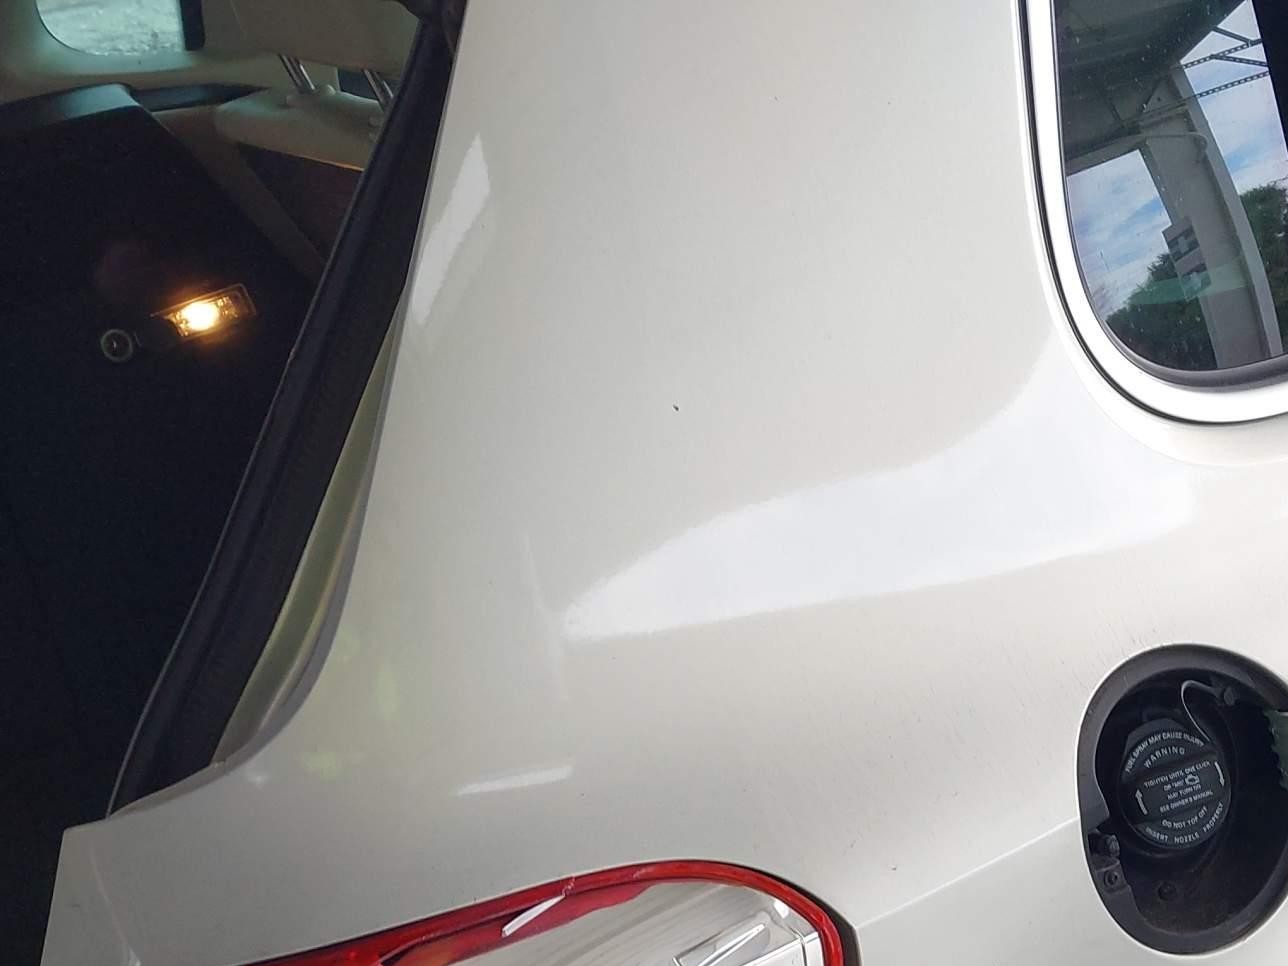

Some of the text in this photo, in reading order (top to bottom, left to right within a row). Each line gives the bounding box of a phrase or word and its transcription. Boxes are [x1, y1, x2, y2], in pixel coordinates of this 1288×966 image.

[1132, 740, 1149, 759] SPRAY
[1148, 734, 1162, 745] MAY
[1162, 731, 1182, 740] CAUSE
[1183, 733, 1205, 747] INJURY
[1143, 746, 1185, 768] WARNING
[1143, 760, 1211, 788] TIGHTEN UNTIL ONE CLICK
[1159, 804, 1170, 813] SEE
[1193, 790, 1214, 801] MANUAL
[1179, 787, 1191, 797] TURN
[1145, 801, 1224, 844] INSERT NOZZLE PROPERLY
[1162, 805, 1208, 830] DO NOT TOP OFF
